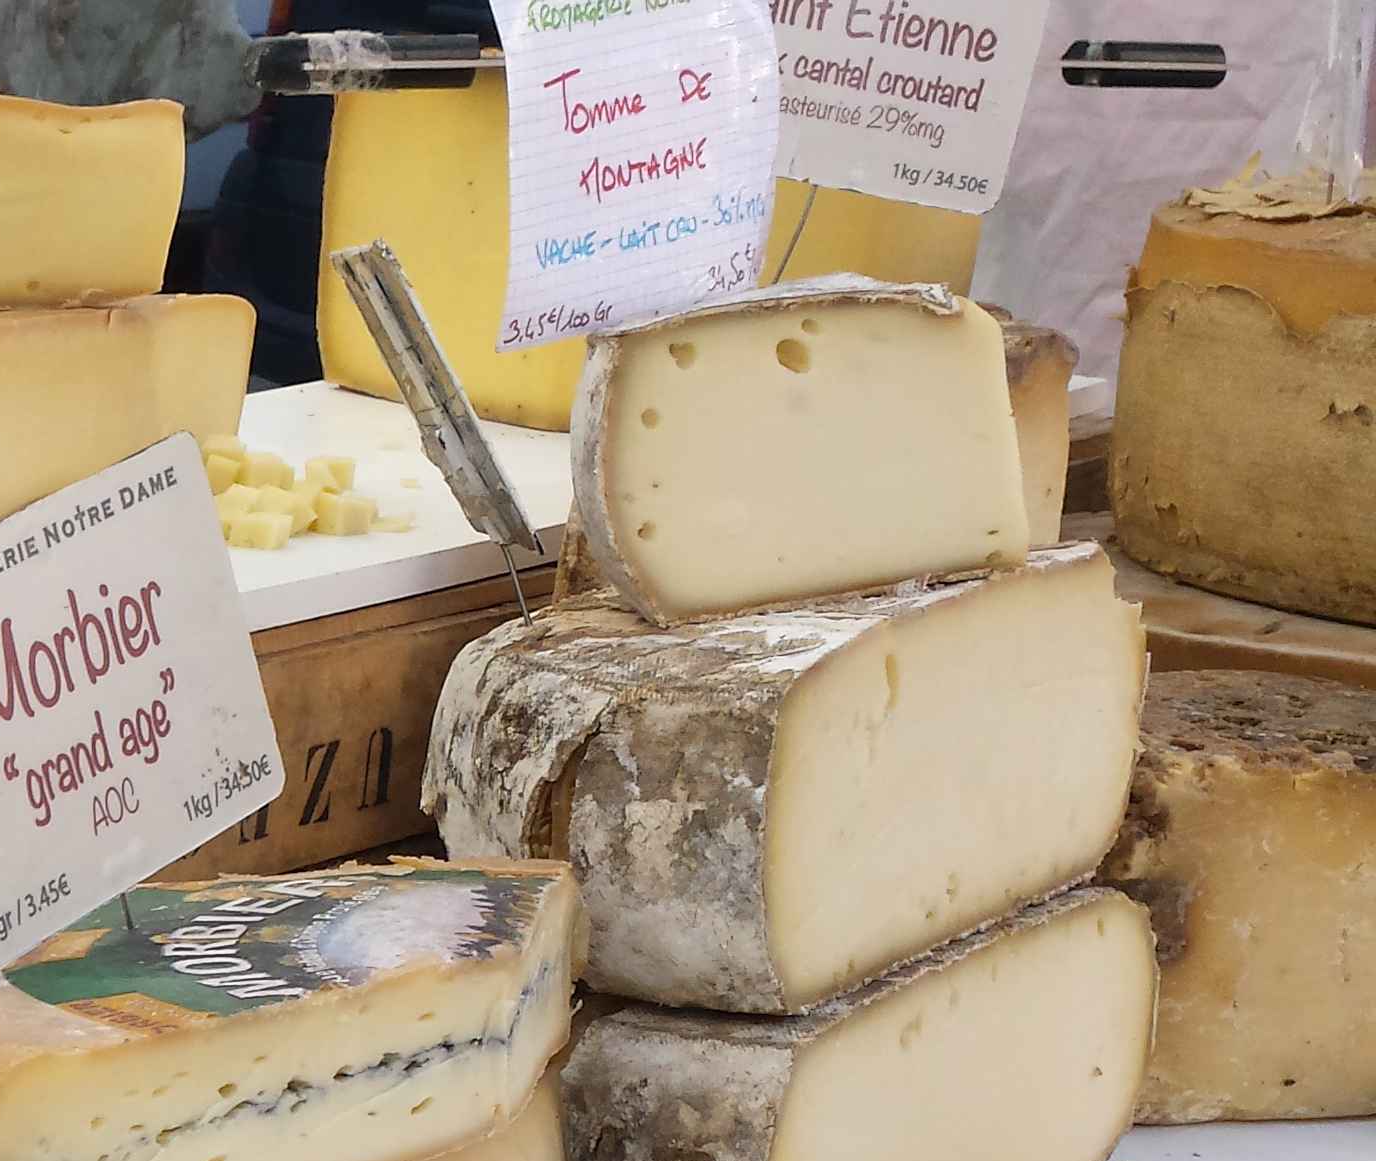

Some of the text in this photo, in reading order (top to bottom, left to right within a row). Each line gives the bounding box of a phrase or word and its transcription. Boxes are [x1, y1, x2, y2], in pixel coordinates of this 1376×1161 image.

[846, 0, 998, 62] Etienne
[543, 68, 646, 134] Tomme
[779, 95, 861, 126] asteurisé
[793, 54, 874, 91] cantal
[876, 71, 985, 112] croutard
[893, 163, 921, 187] 1kg
[935, 170, 989, 195] 34.50€
[42, 505, 116, 549] NOTRE
[118, 466, 178, 512] DAME
[92, 776, 139, 836] AOC
[183, 793, 212, 822] 1kg
[23, 873, 72, 918] 3.45€
[160, 878, 355, 1000] MORBIER
